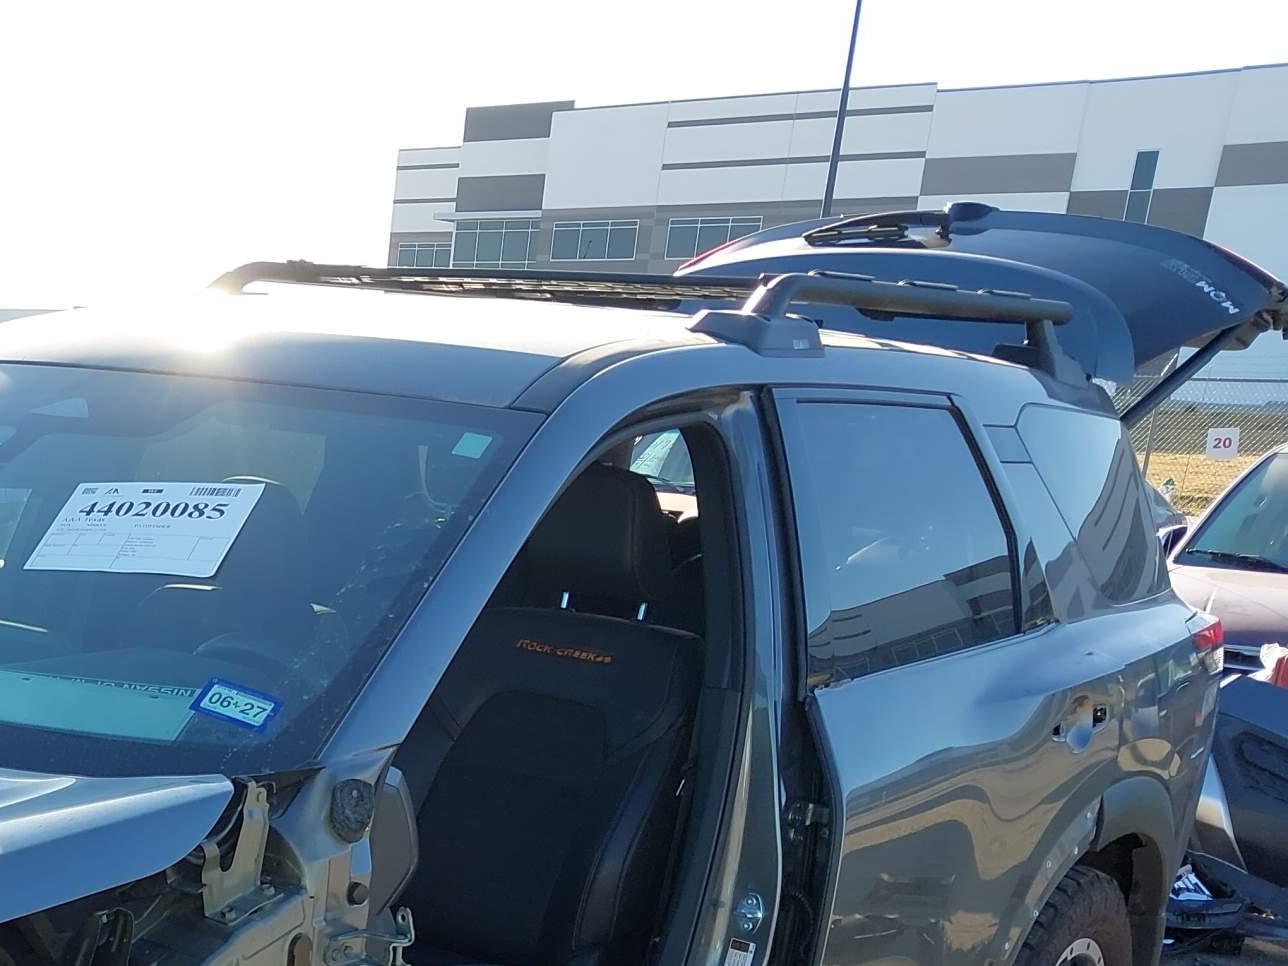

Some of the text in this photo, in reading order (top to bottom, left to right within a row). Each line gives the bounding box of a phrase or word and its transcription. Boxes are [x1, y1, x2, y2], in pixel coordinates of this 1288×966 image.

[1213, 437, 1232, 449] 20
[78, 500, 231, 520] 44020085
[516, 639, 595, 661] ROCK CREEK
